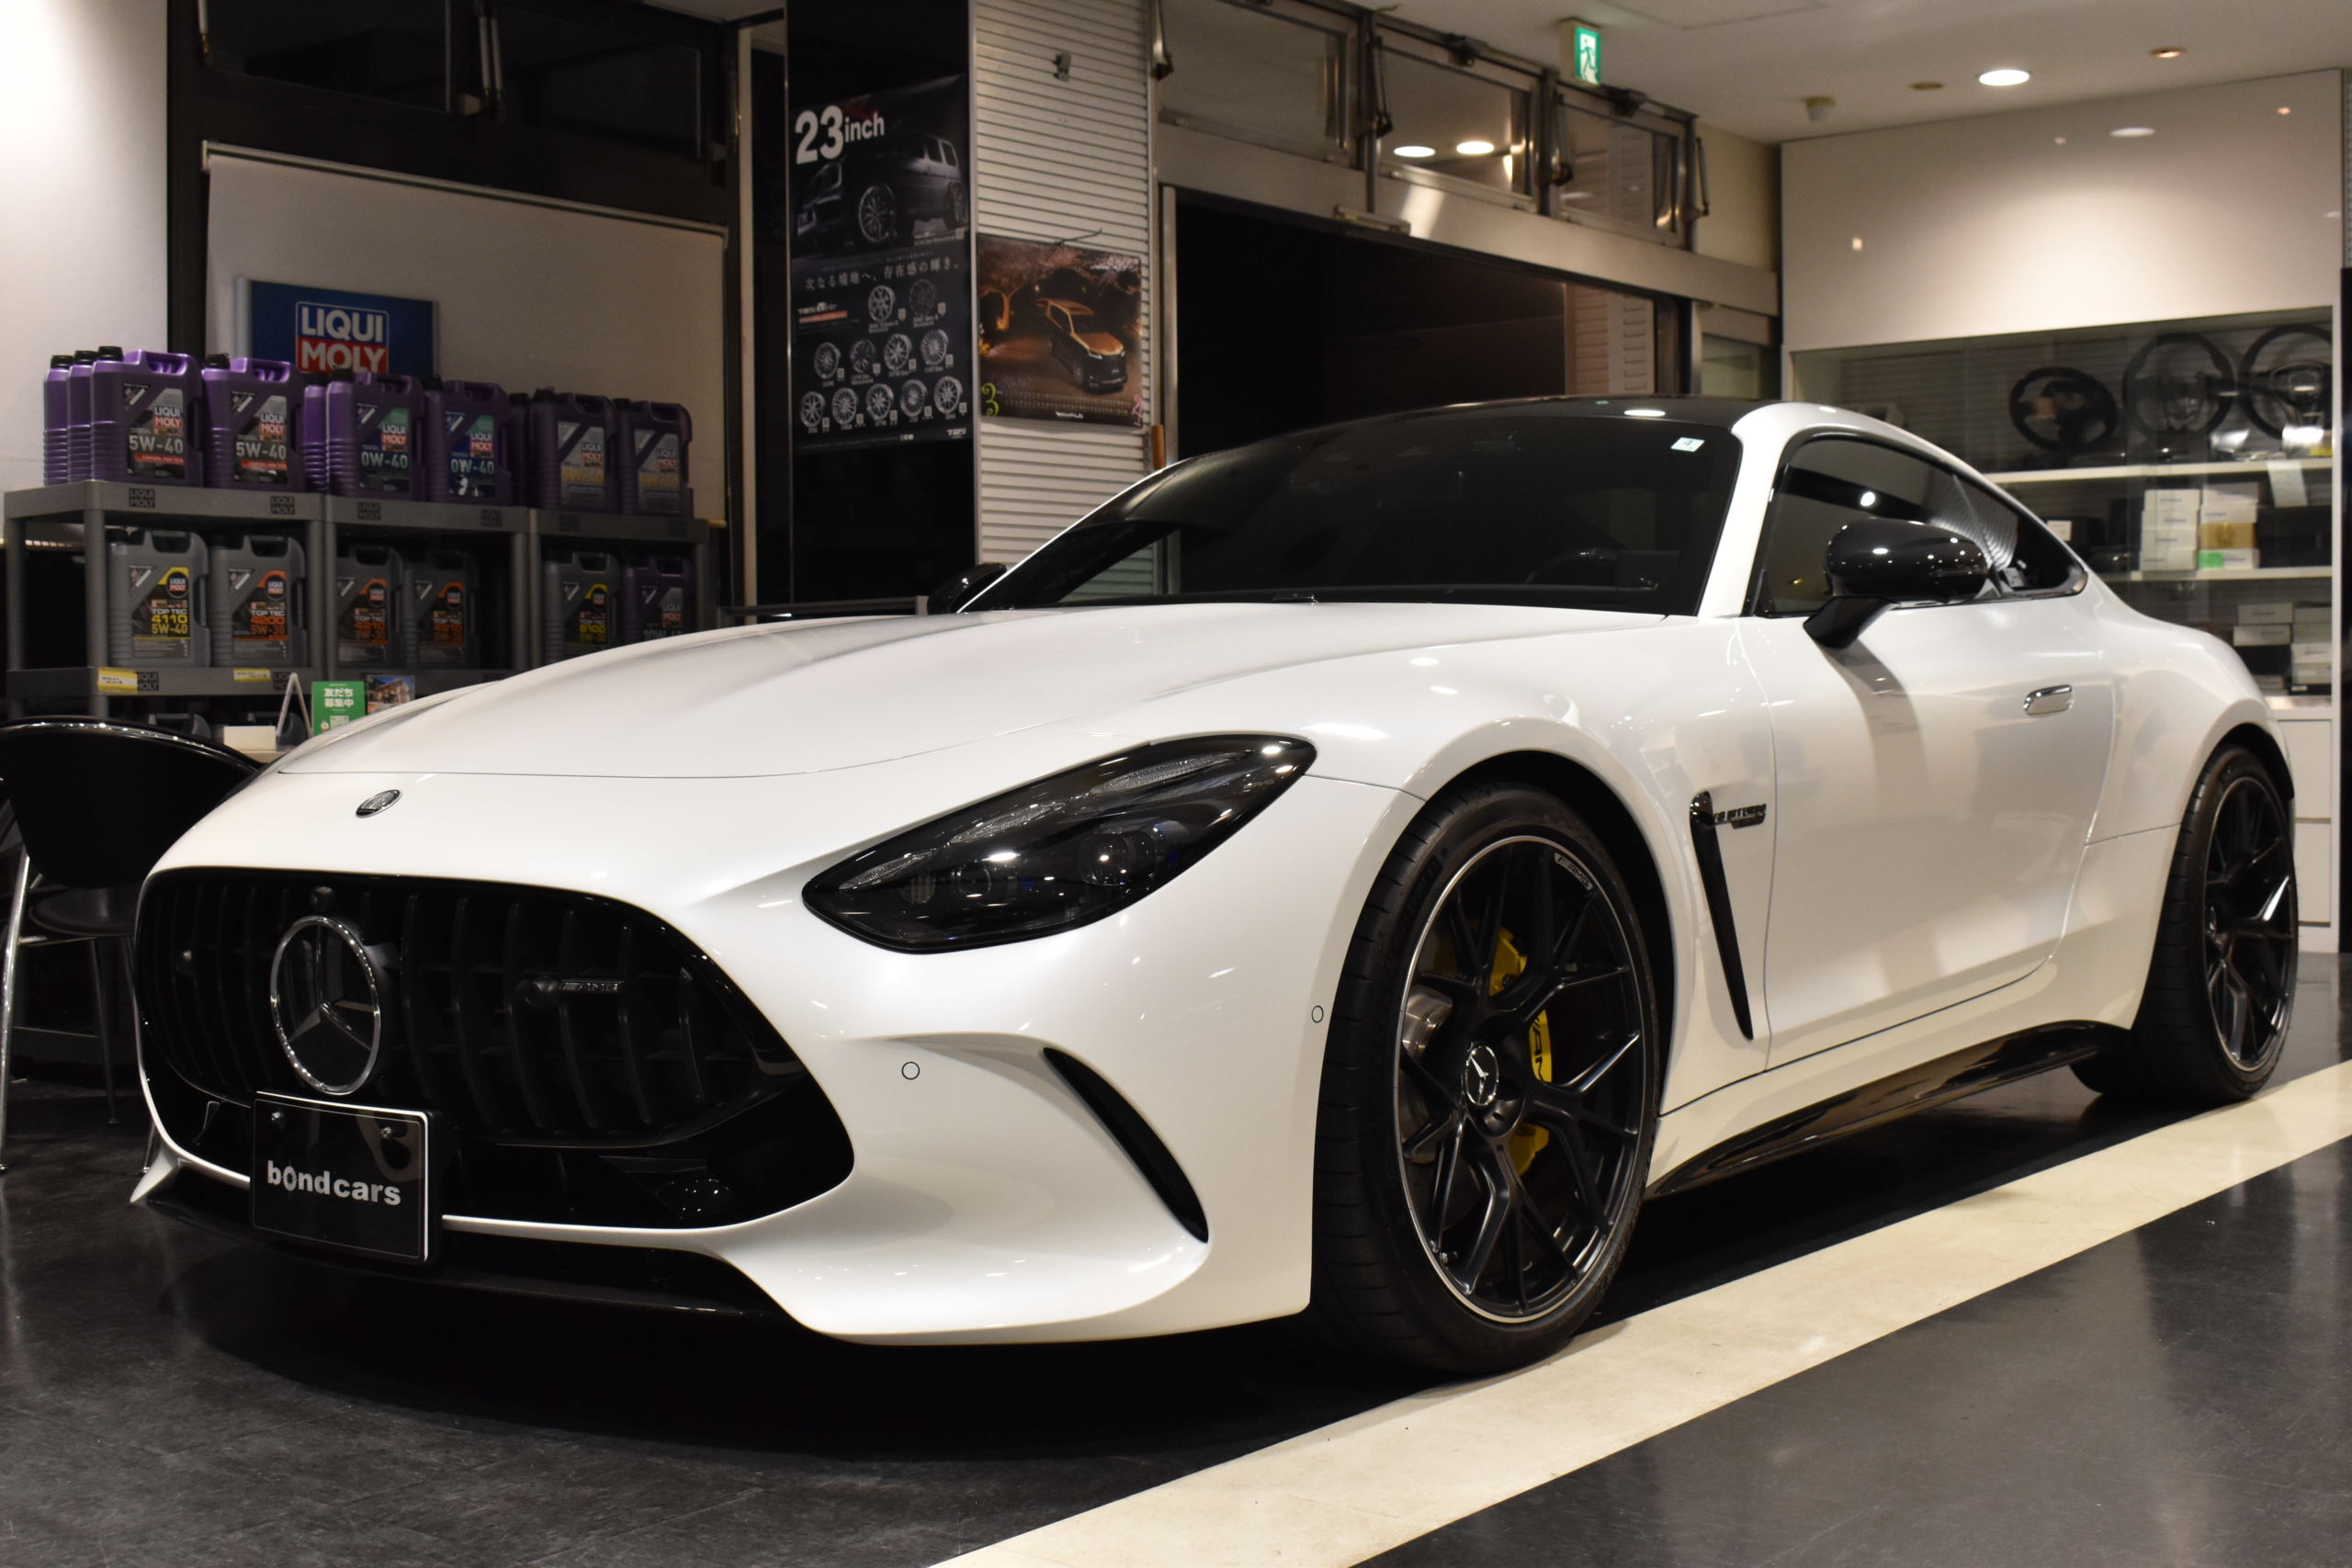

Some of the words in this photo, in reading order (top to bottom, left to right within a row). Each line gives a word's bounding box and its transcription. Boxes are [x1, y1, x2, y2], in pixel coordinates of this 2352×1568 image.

[301, 306, 383, 343] LIQUI
[301, 339, 386, 373] MOLY
[981, 382, 999, 416] 3
[154, 406, 180, 417] LIQUI
[1132, 395, 1143, 427] 4
[154, 417, 182, 427] MOLY
[260, 413, 285, 423] LIQUI
[261, 423, 285, 434] MOLY
[383, 424, 406, 434] LIQUI
[383, 434, 407, 445] MOLY
[471, 432, 492, 441] LIQUI
[129, 435, 184, 455] 5W-40
[471, 441, 492, 451] MOLY
[582, 443, 602, 451] LIQUI
[235, 442, 287, 460] 5W-40
[582, 451, 603, 461] MOLY
[658, 449, 676, 457] LIQUI
[361, 452, 408, 469] 0W-40
[658, 457, 677, 468] MOLY
[450, 458, 494, 475] 0W-40
[130, 489, 154, 499] LIQUI
[130, 498, 154, 507] MOLY
[272, 497, 294, 505] LIQUI
[272, 505, 294, 514] MOLY
[169, 577, 187, 585] LIQUI
[663, 604, 681, 612] LIQUI
[151, 615, 188, 624] 4110
[250, 616, 286, 625] 4200
[662, 612, 682, 621] MOLY
[152, 624, 188, 635] 5W-40
[251, 625, 286, 635] 5W-30
[354, 622, 386, 630] 4210
[323, 687, 354, 697] 友だち
[324, 698, 354, 708] 募集中
[1567, 863, 1589, 887] AMG
[1408, 877, 1428, 914] SPORT
